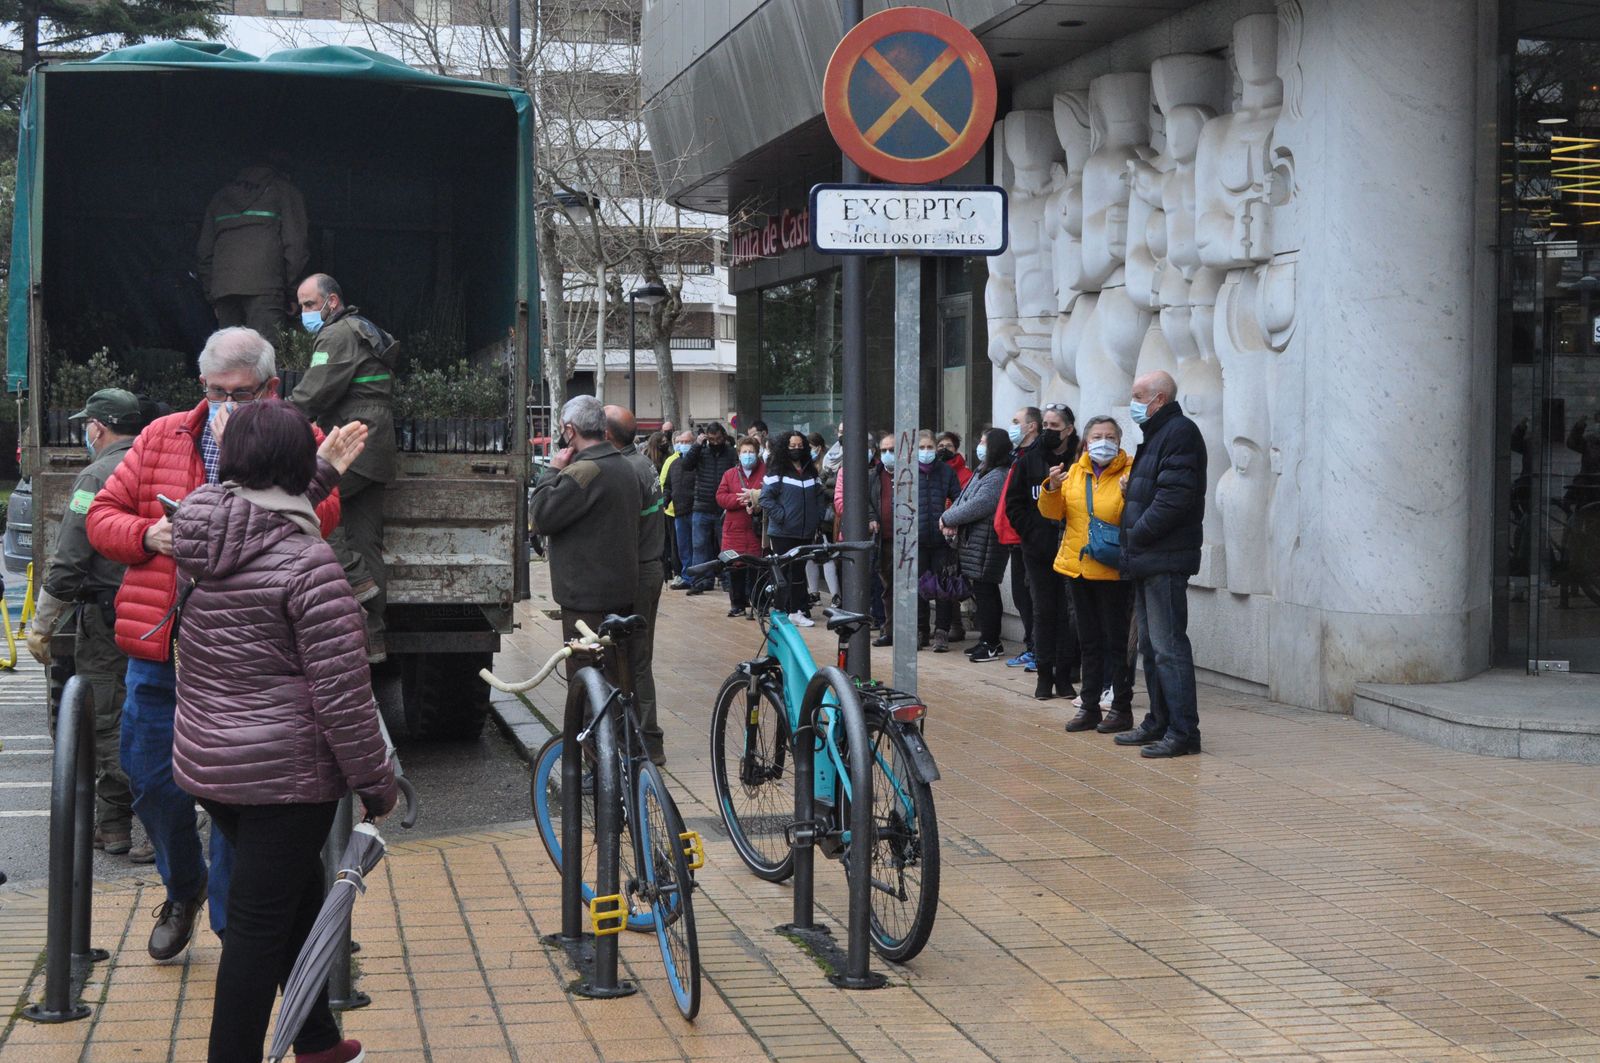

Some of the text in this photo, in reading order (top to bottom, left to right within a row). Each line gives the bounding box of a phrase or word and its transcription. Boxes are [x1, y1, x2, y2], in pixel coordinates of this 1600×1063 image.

[729, 207, 810, 268] Junta de Cast
